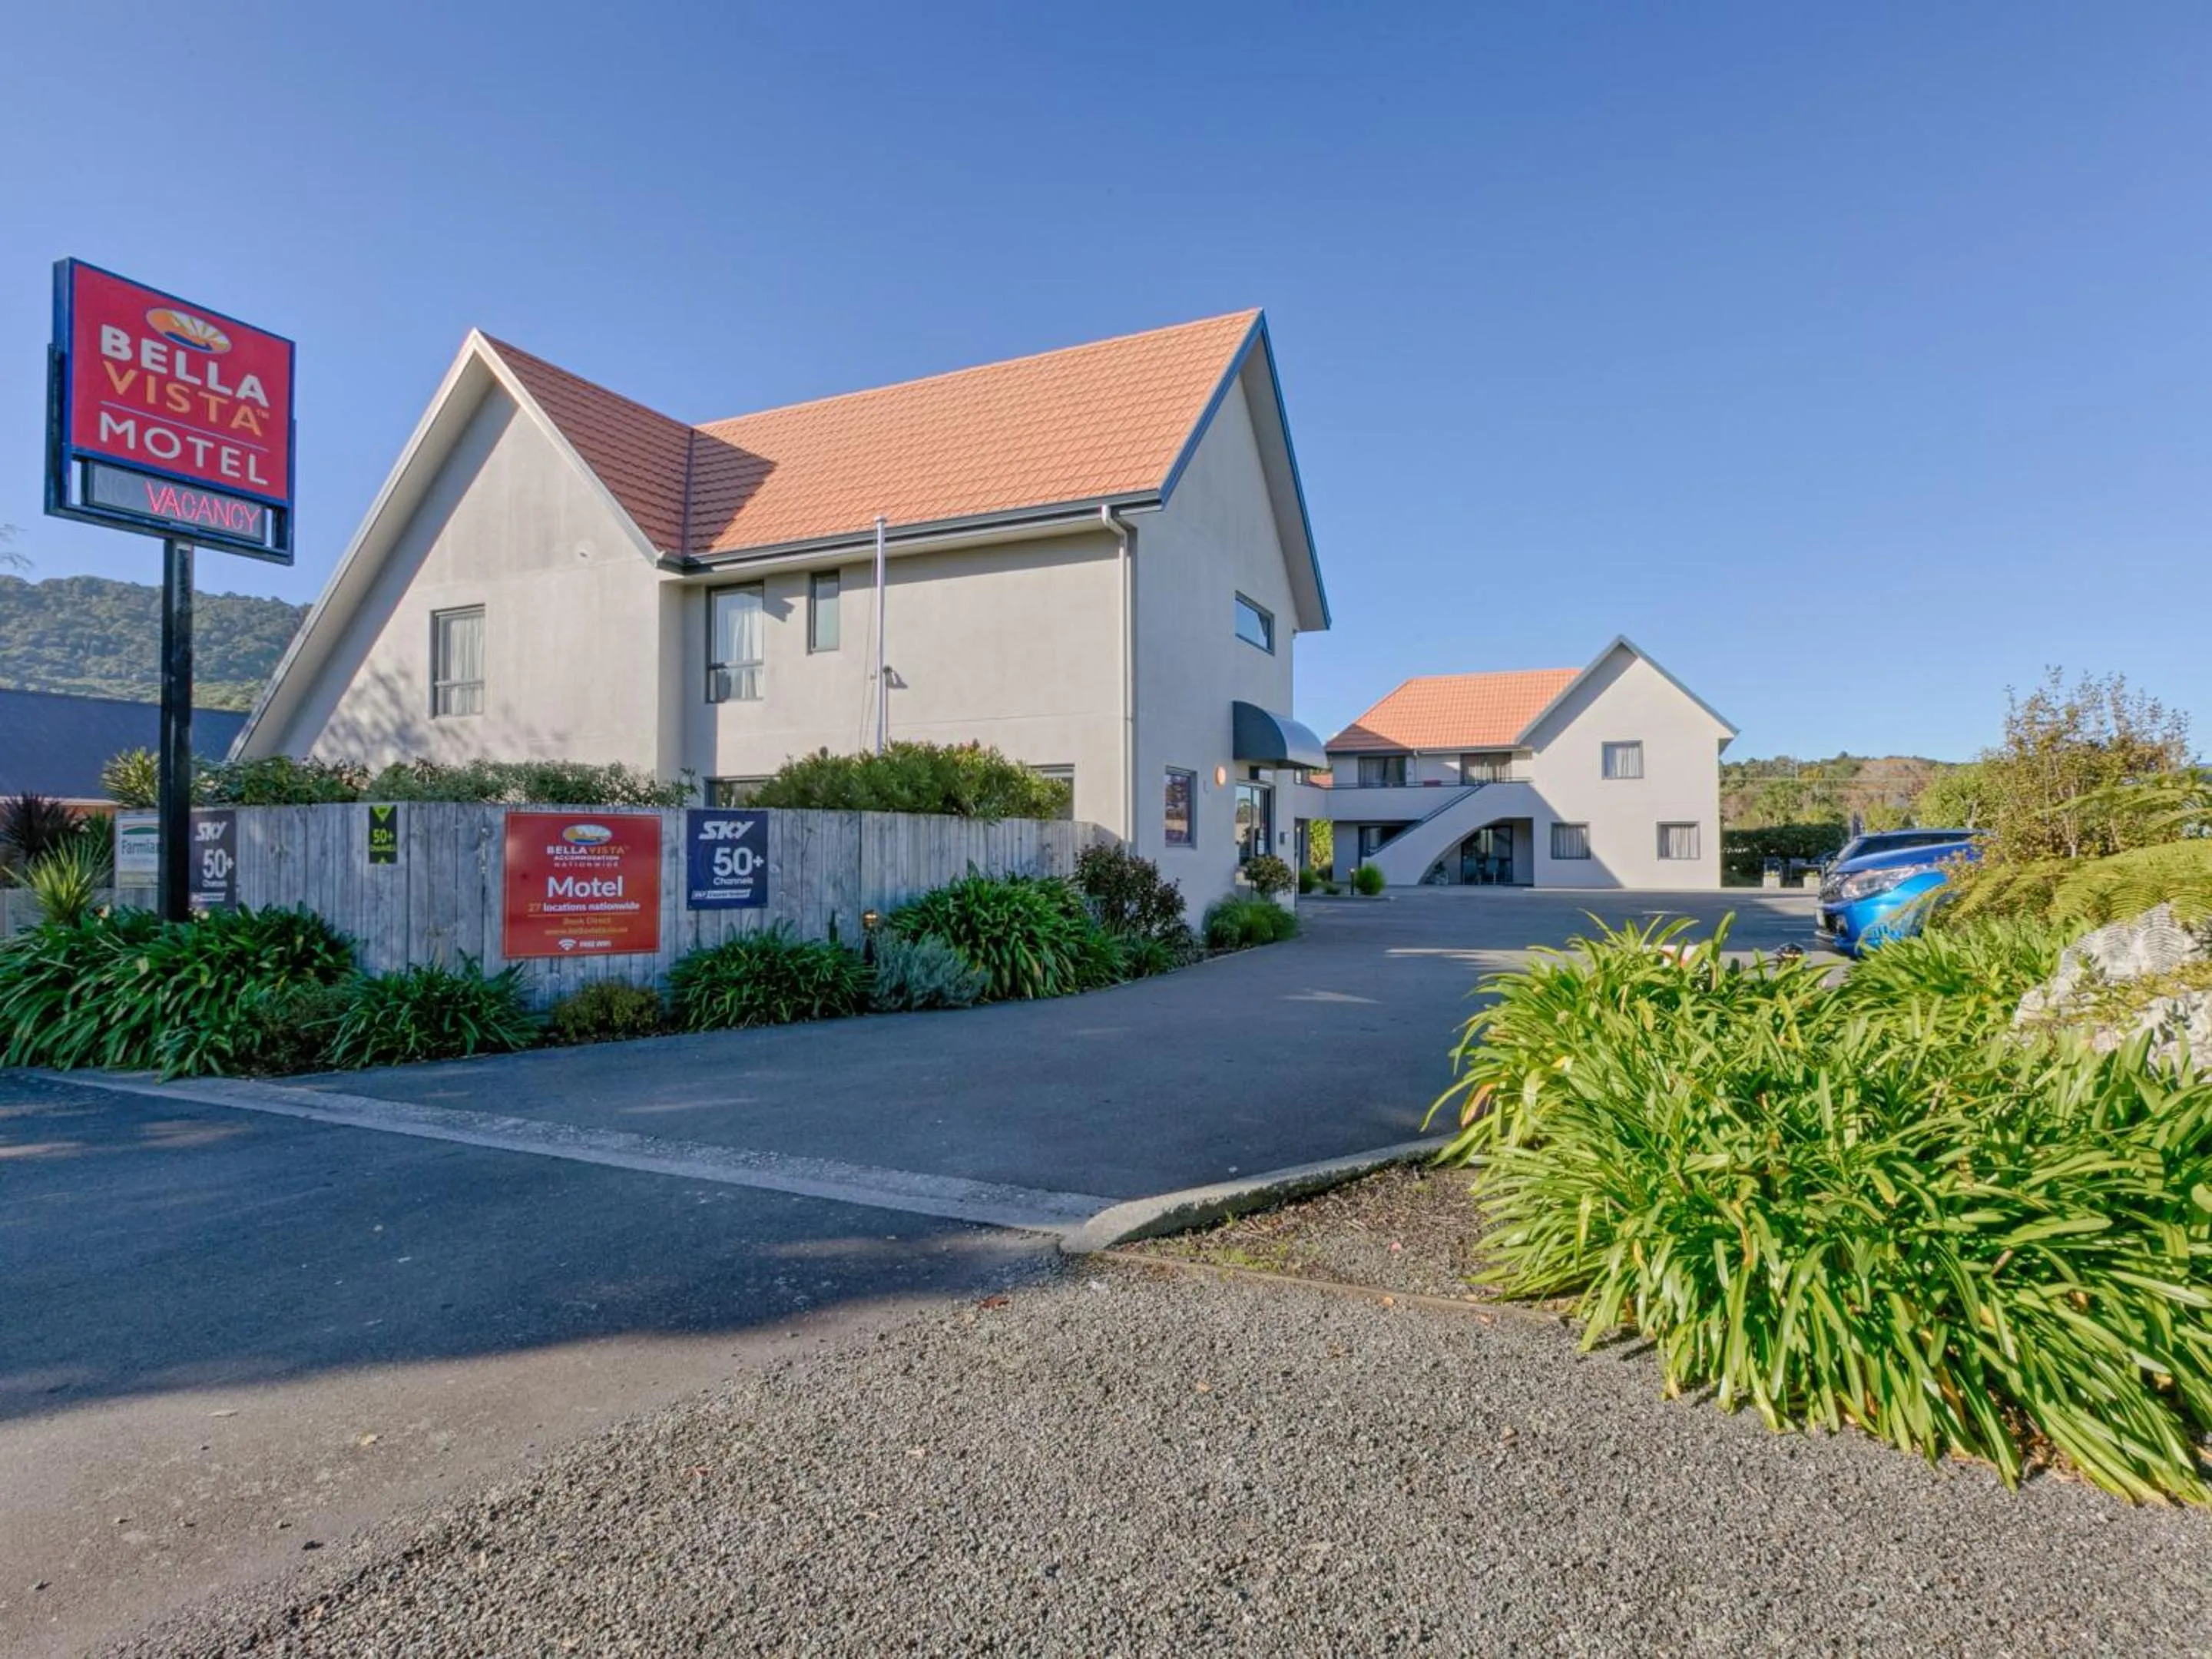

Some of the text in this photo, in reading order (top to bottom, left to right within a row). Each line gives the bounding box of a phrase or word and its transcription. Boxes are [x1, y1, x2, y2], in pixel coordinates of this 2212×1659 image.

[101, 324, 270, 408] BELLA
[100, 411, 269, 485] MOTEL
[144, 479, 261, 533] VACANCY
[194, 821, 227, 842] SKY
[373, 828, 394, 844] 50+
[697, 820, 756, 839] SKY
[547, 846, 625, 855] BELLA VISTA
[713, 846, 764, 876] 50+
[202, 848, 233, 879] 50+
[548, 875, 624, 898] Motel
[543, 902, 586, 912] locations
[588, 900, 640, 911] nationwide
